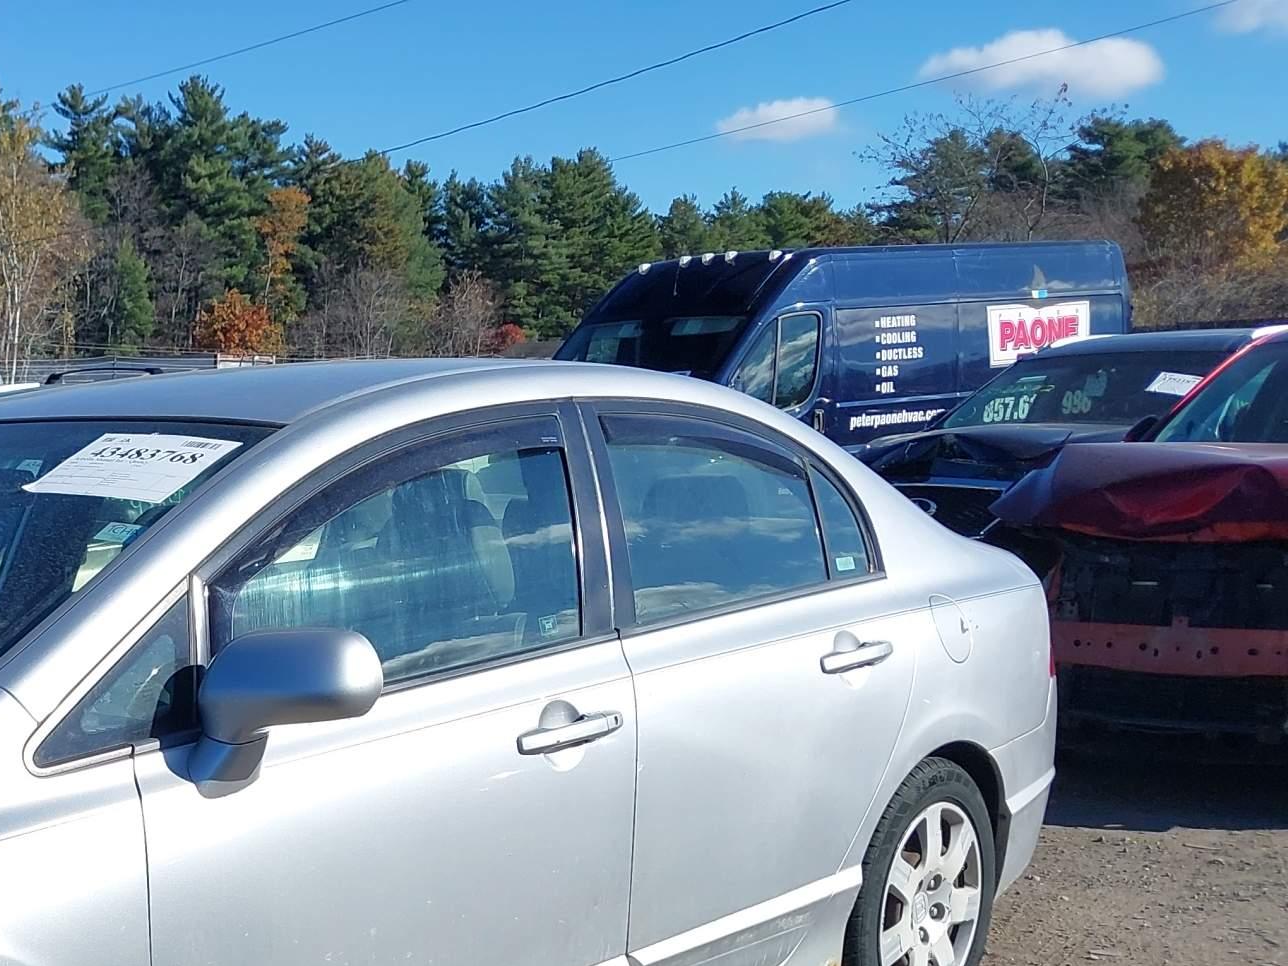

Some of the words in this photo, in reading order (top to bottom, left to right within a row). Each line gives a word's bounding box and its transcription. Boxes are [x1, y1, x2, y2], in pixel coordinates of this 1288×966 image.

[880, 314, 916, 328] HEATING
[880, 331, 917, 345] COOLING
[999, 315, 1079, 351] PAONE
[881, 346, 924, 361] DUCTLESS
[881, 364, 899, 378] GAS
[881, 381, 895, 394] OIL
[849, 408, 945, 431] peterpaonehvac.co
[89, 445, 205, 465] 43483768
